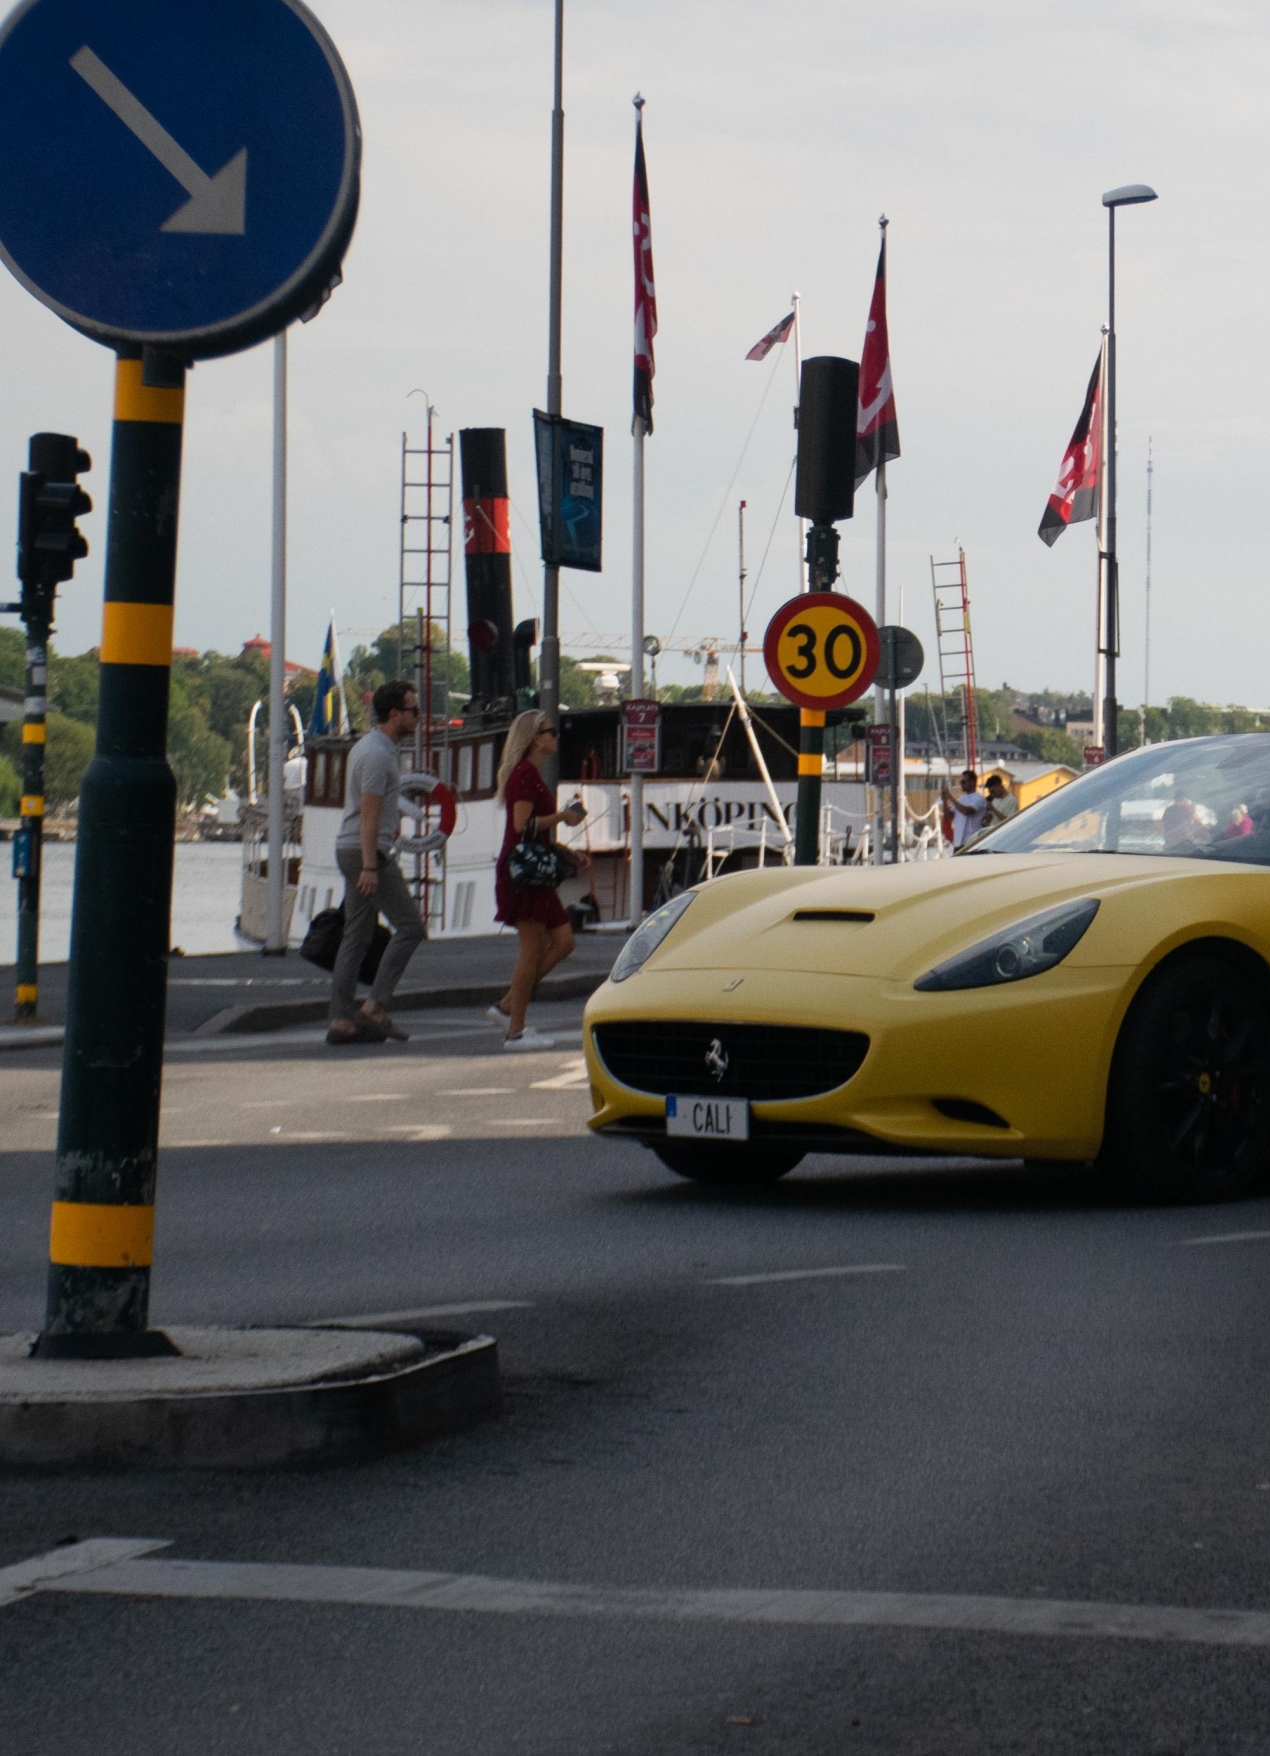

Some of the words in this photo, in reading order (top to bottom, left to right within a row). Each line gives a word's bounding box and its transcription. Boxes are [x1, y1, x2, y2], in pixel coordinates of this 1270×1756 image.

[786, 624, 862, 679] 30
[637, 712, 647, 724] 7
[692, 1102, 731, 1134] CALI
